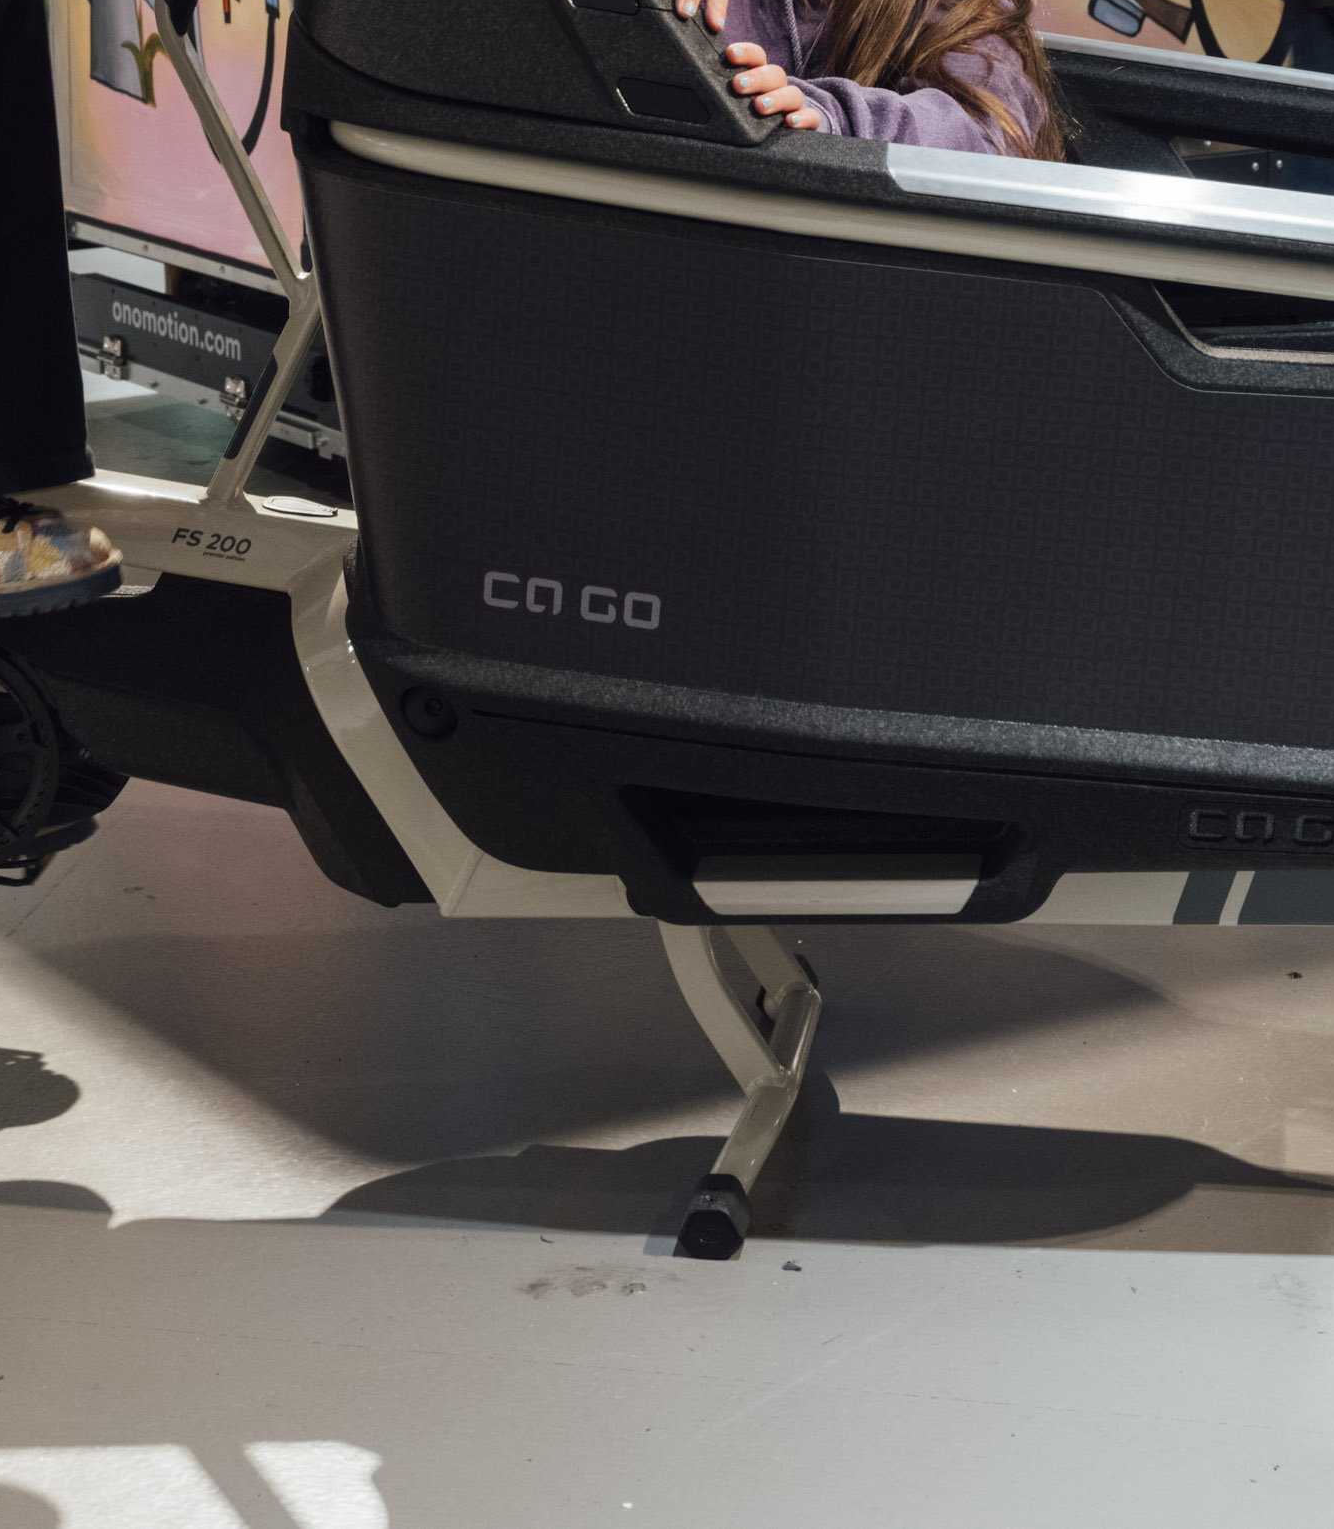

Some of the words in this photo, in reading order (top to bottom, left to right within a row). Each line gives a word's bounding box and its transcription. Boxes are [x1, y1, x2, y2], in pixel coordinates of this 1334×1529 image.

[111, 299, 243, 361] onomotion.com
[171, 528, 203, 548] FS
[206, 532, 252, 556] 200
